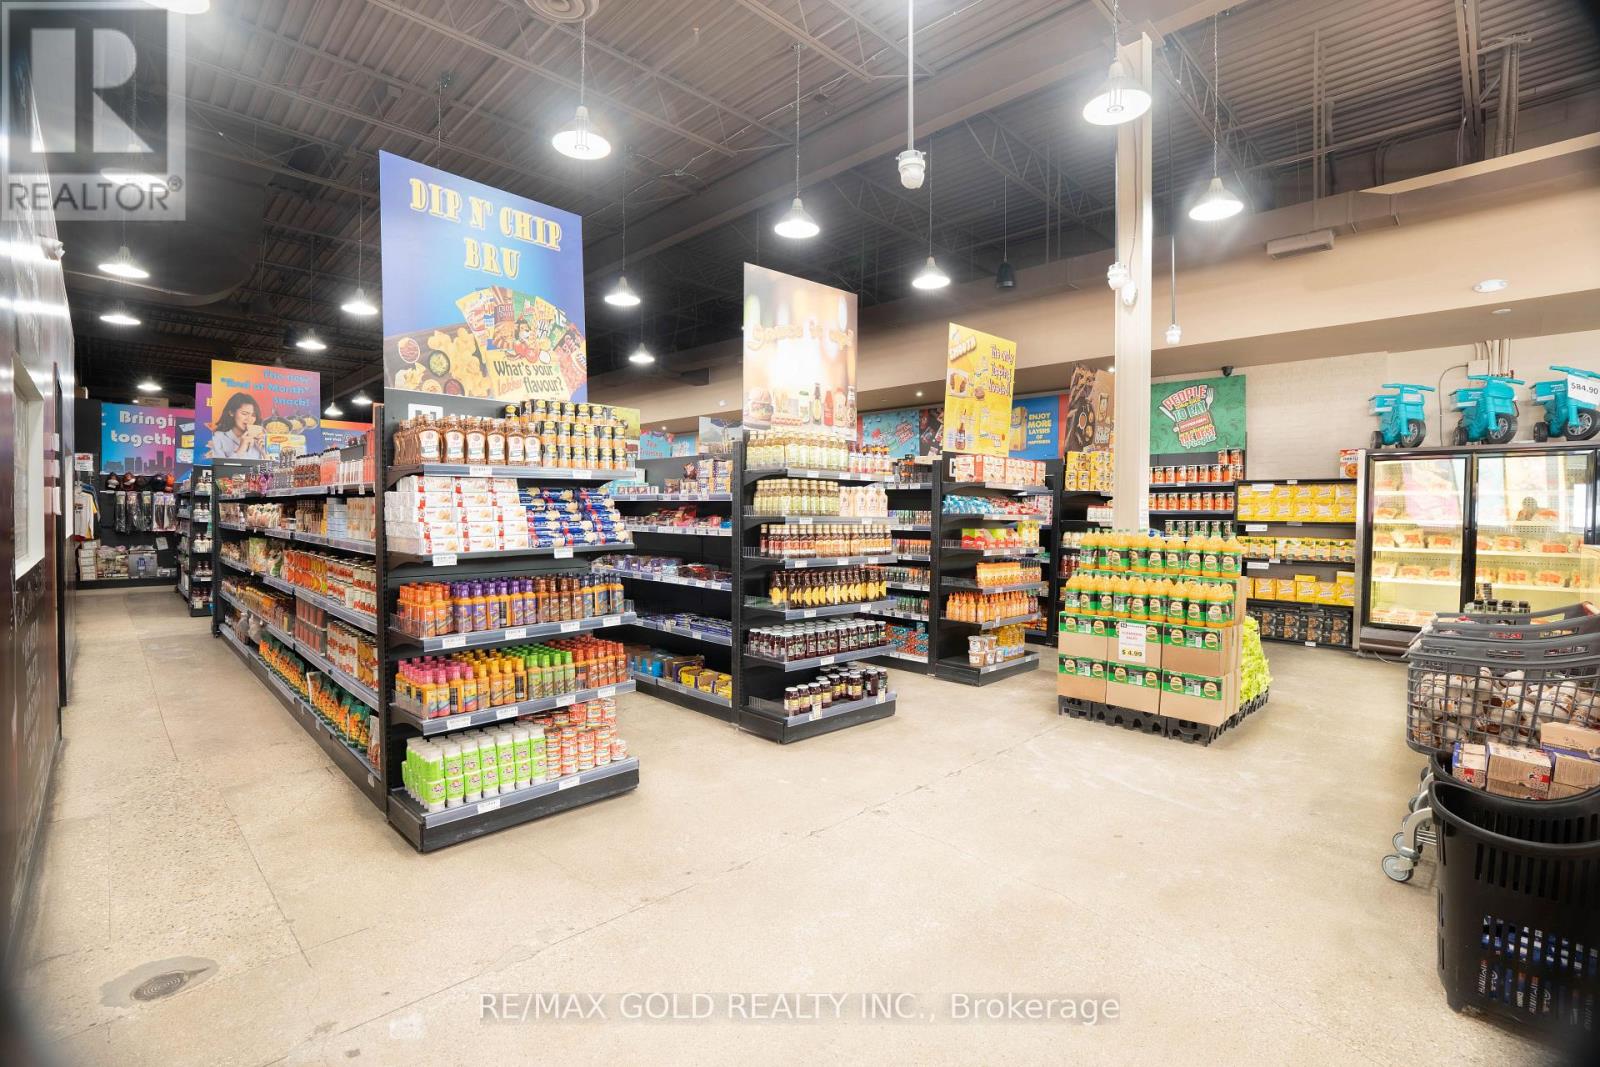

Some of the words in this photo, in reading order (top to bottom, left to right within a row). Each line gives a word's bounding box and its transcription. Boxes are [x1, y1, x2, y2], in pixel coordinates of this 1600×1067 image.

[409, 178, 463, 223] DIP
[499, 207, 562, 251] CHIP
[464, 237, 521, 279] BRU
[493, 360, 532, 376] What's
[532, 363, 553, 377] your
[523, 376, 563, 394] flavour?
[1162, 384, 1208, 411] PEOPLE
[120, 410, 176, 429] Bringi
[1028, 412, 1051, 421] ENJOY
[1173, 408, 1187, 422] TO
[1187, 400, 1207, 418] EAT
[1028, 419, 1052, 429] MORE
[1028, 427, 1051, 435] LAYERS
[111, 429, 176, 448] togeth
